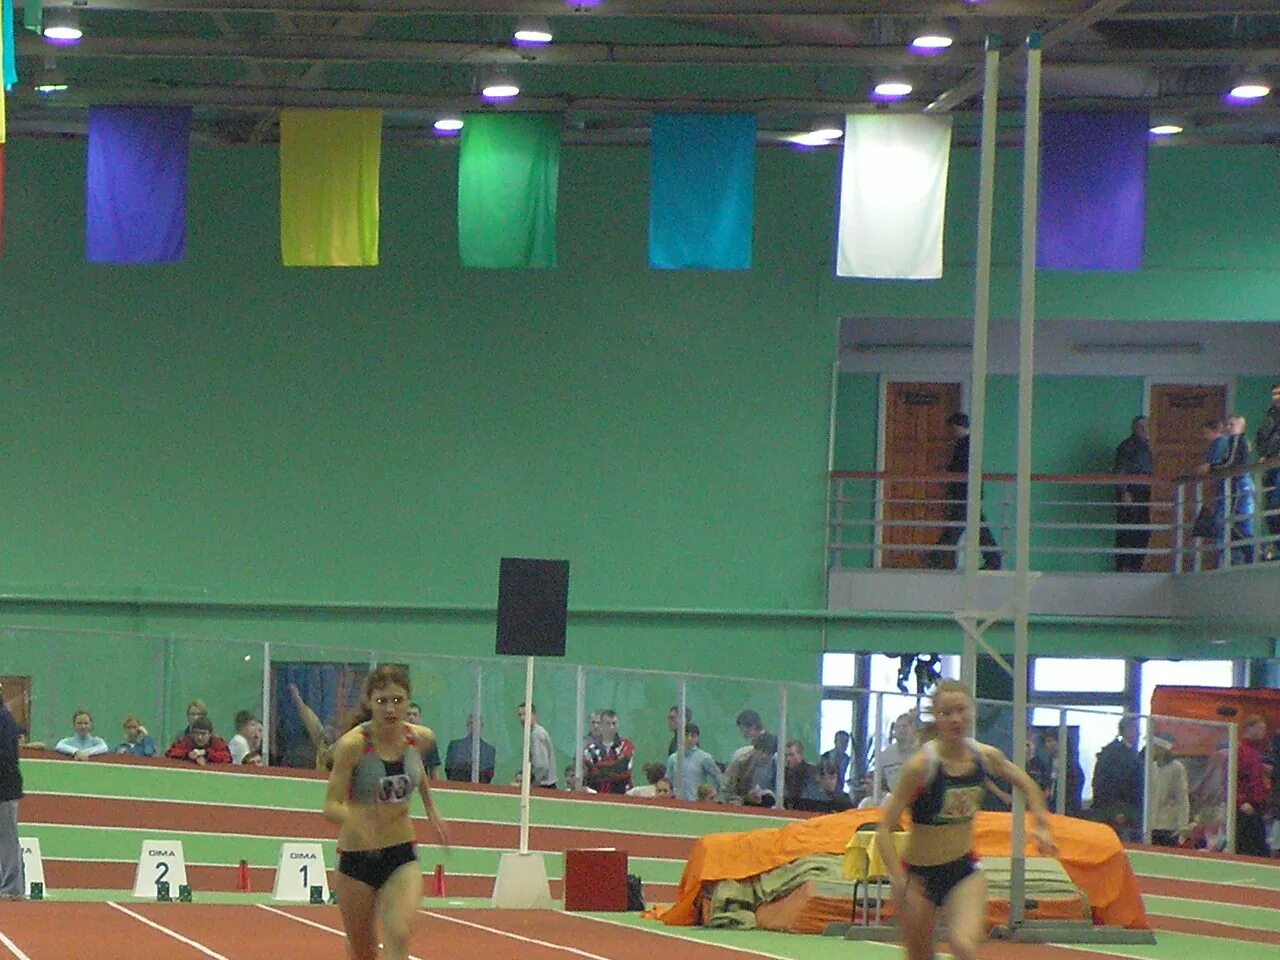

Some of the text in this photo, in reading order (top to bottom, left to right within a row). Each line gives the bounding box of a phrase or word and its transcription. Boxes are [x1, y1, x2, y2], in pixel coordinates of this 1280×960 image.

[148, 849, 176, 858] DIMA
[289, 852, 318, 861] DIMA
[154, 861, 170, 885] 2
[297, 865, 309, 888] 1
